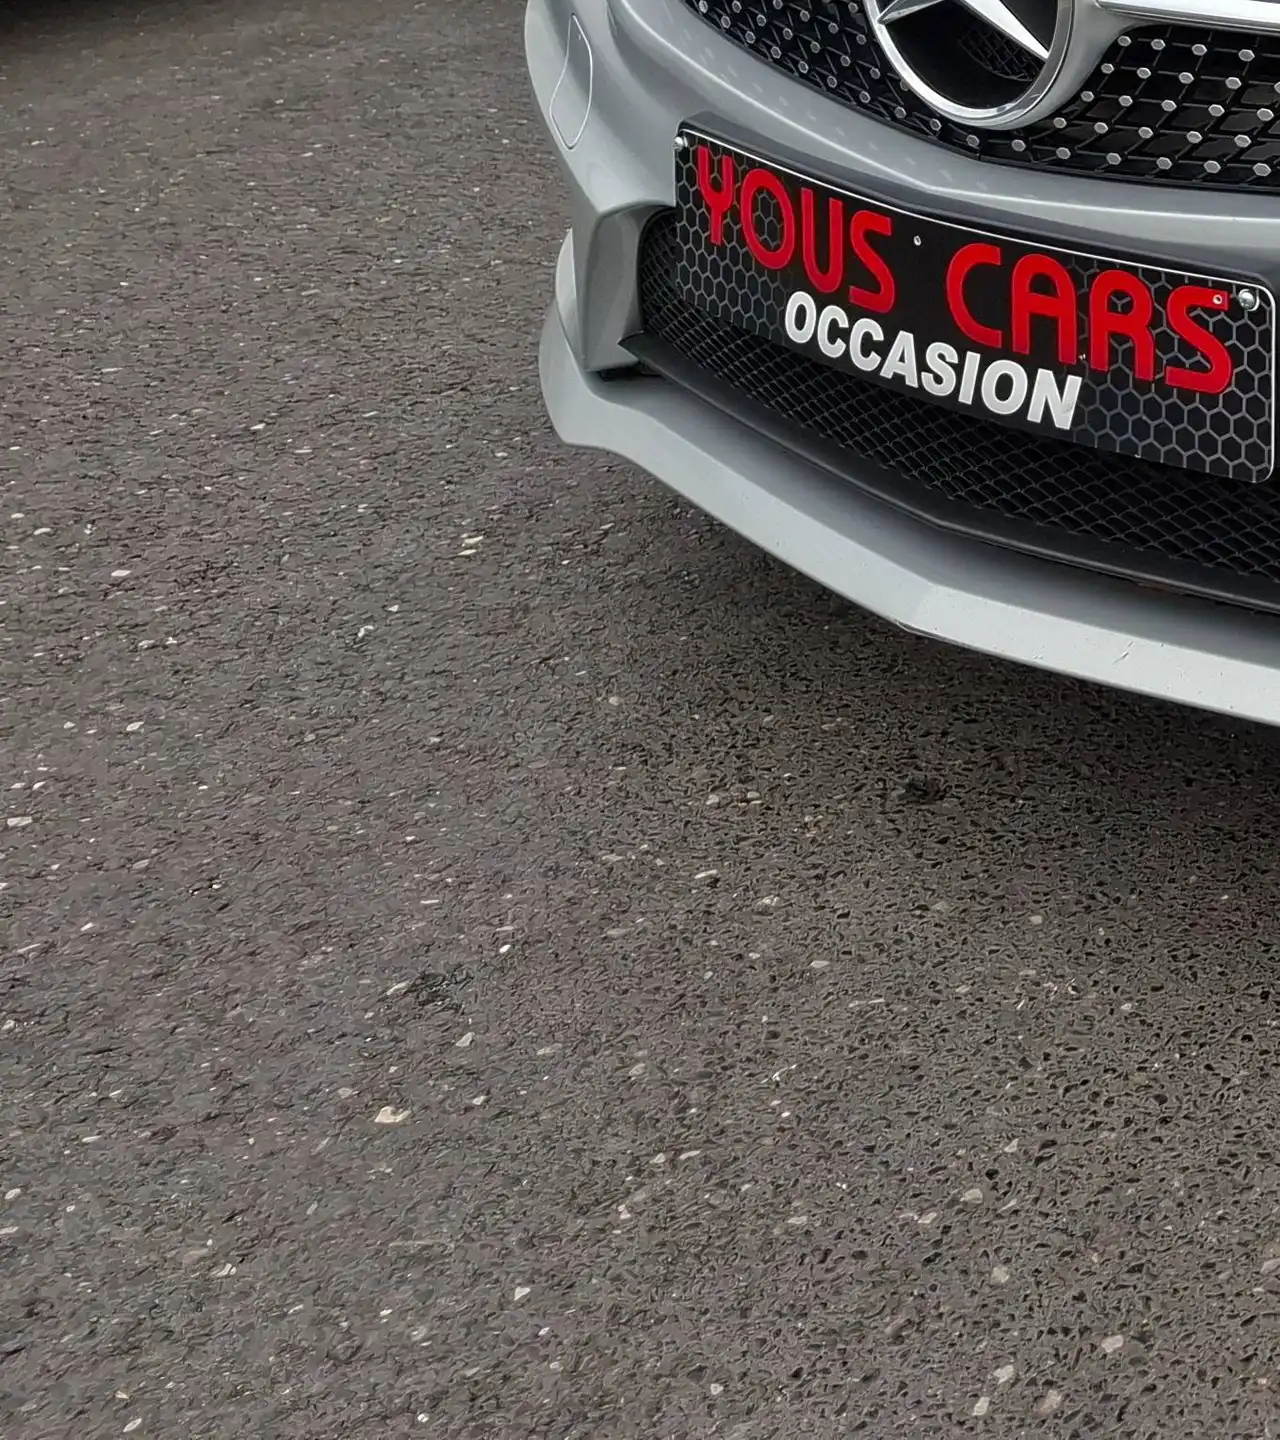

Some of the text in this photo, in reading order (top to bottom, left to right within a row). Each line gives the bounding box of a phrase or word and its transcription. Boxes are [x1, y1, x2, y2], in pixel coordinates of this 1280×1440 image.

[696, 146, 1233, 394] YOUS CARS
[784, 291, 1082, 431] OCCASION
